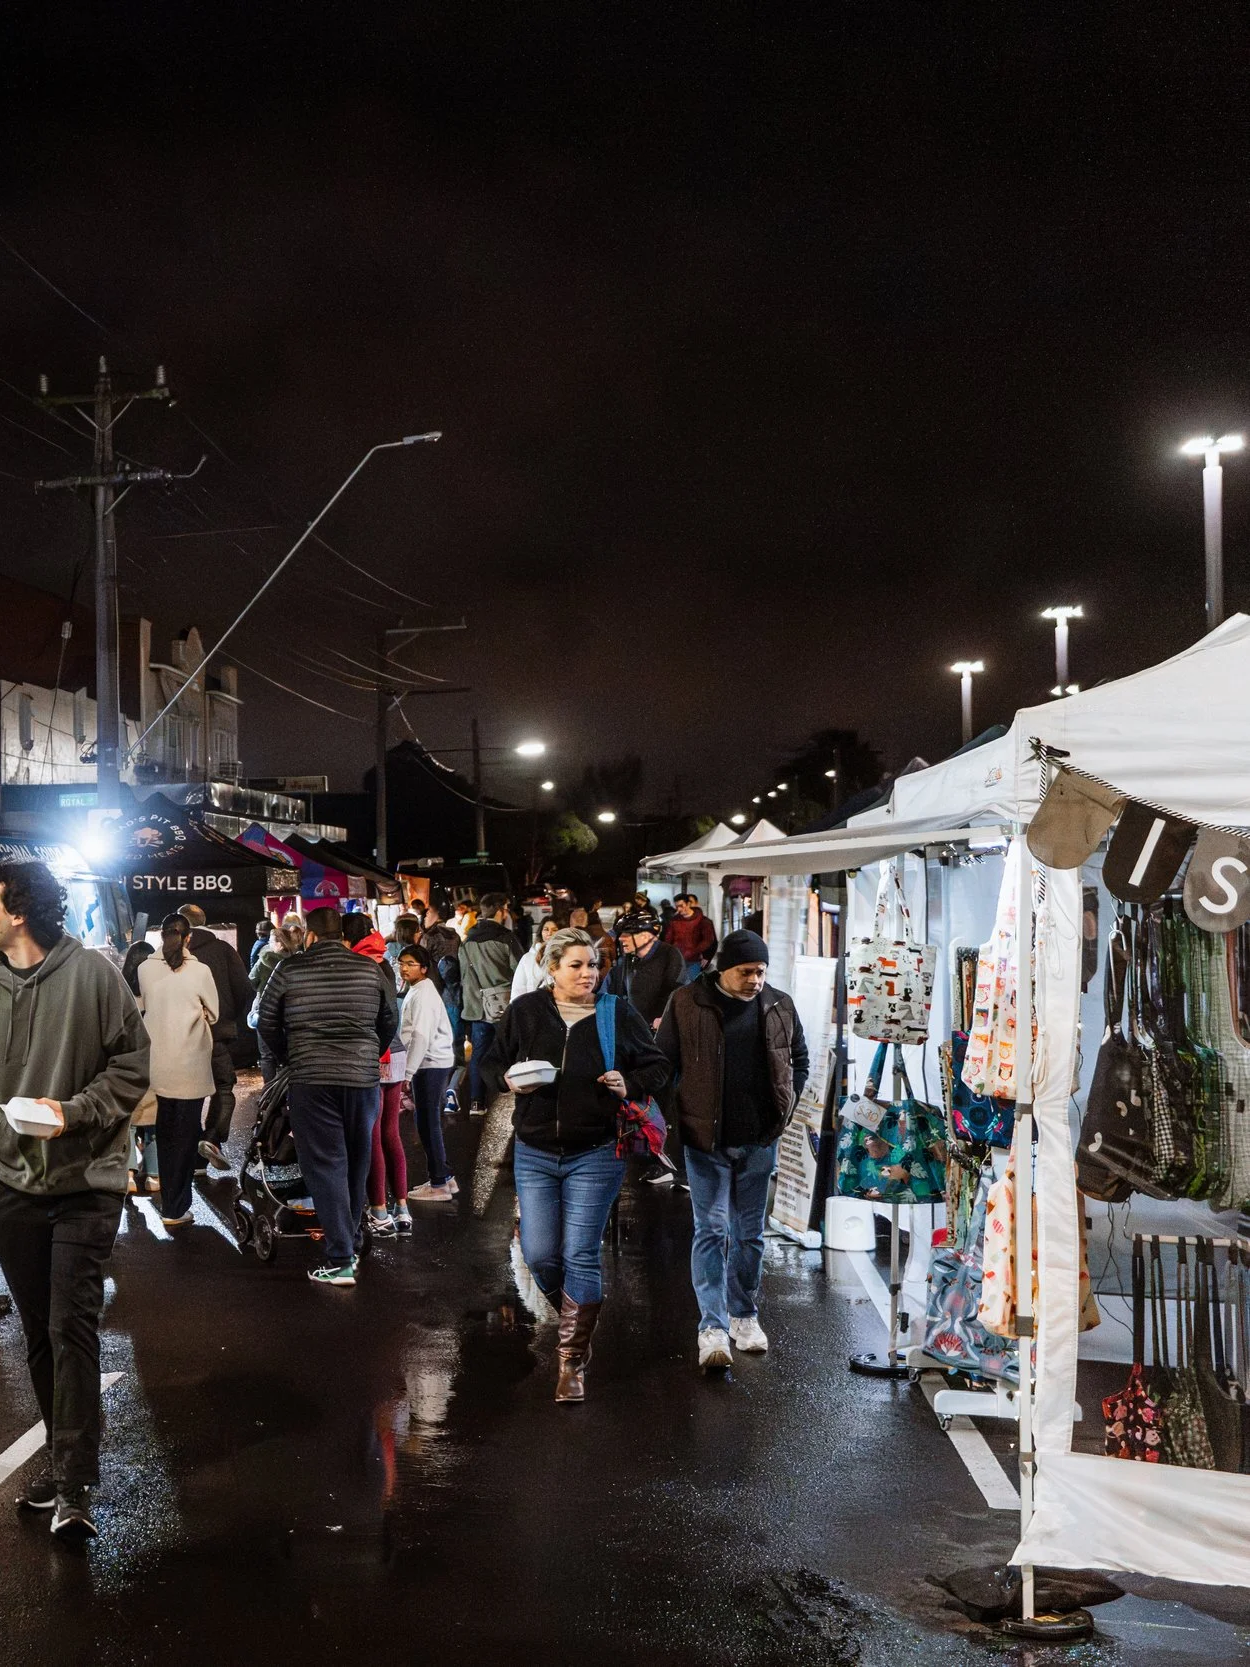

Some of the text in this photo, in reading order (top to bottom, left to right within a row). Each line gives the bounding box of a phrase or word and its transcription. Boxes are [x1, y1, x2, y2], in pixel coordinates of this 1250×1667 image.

[61, 798, 85, 807] ROYAL
[150, 814, 171, 825] PIT
[170, 824, 187, 842] BBQ
[147, 844, 185, 859] MEATS
[132, 875, 188, 891] STYLE
[193, 874, 233, 893] BBQ
